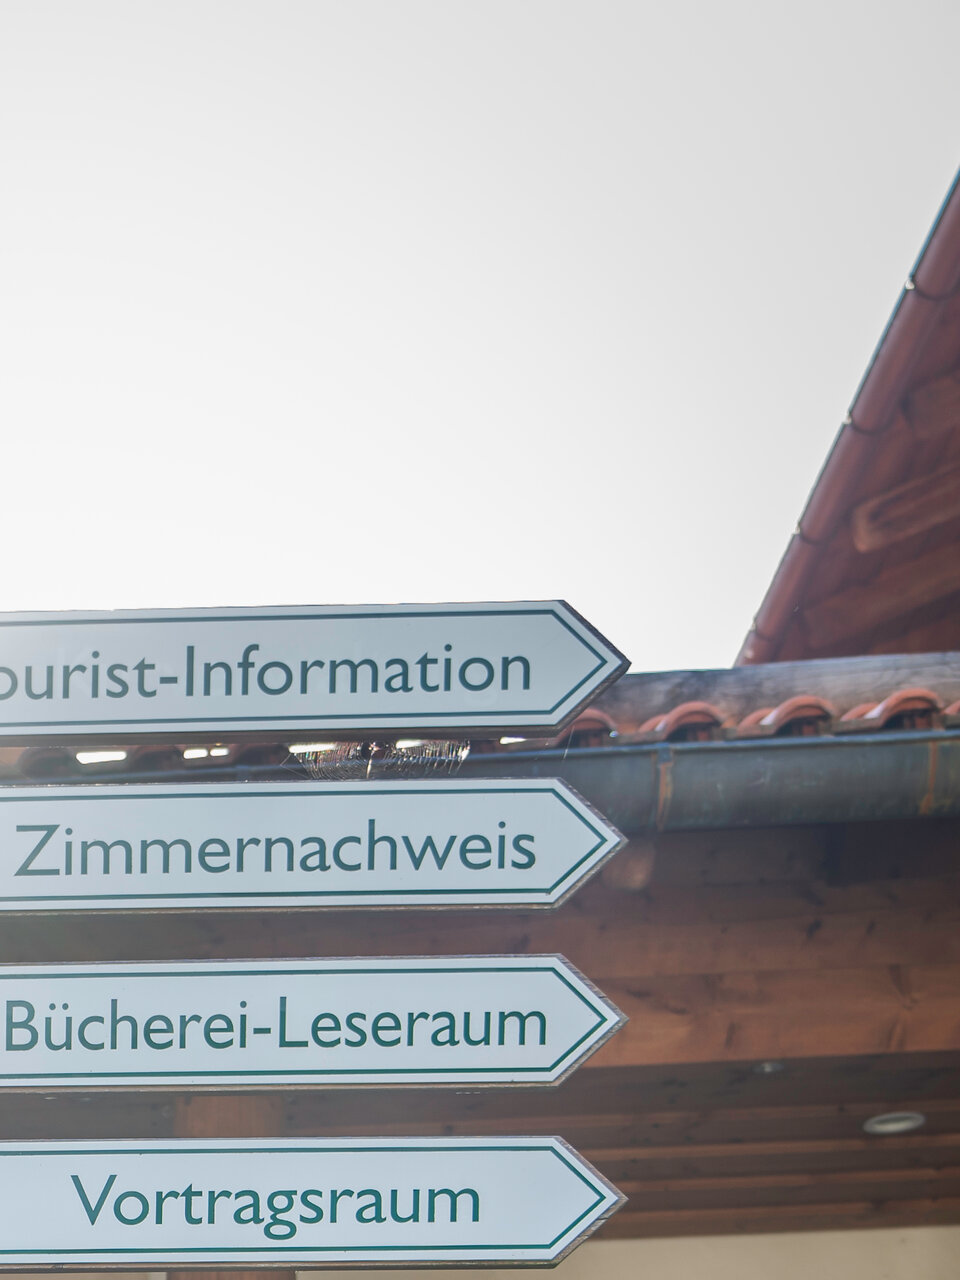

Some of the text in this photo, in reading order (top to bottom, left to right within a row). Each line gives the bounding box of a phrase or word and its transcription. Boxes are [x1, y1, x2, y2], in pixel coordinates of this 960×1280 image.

[14, 819, 537, 877] Zimmernachweis
[5, 996, 547, 1052] Bücherei-Leseraum
[70, 1174, 480, 1240] Vortragsraum
